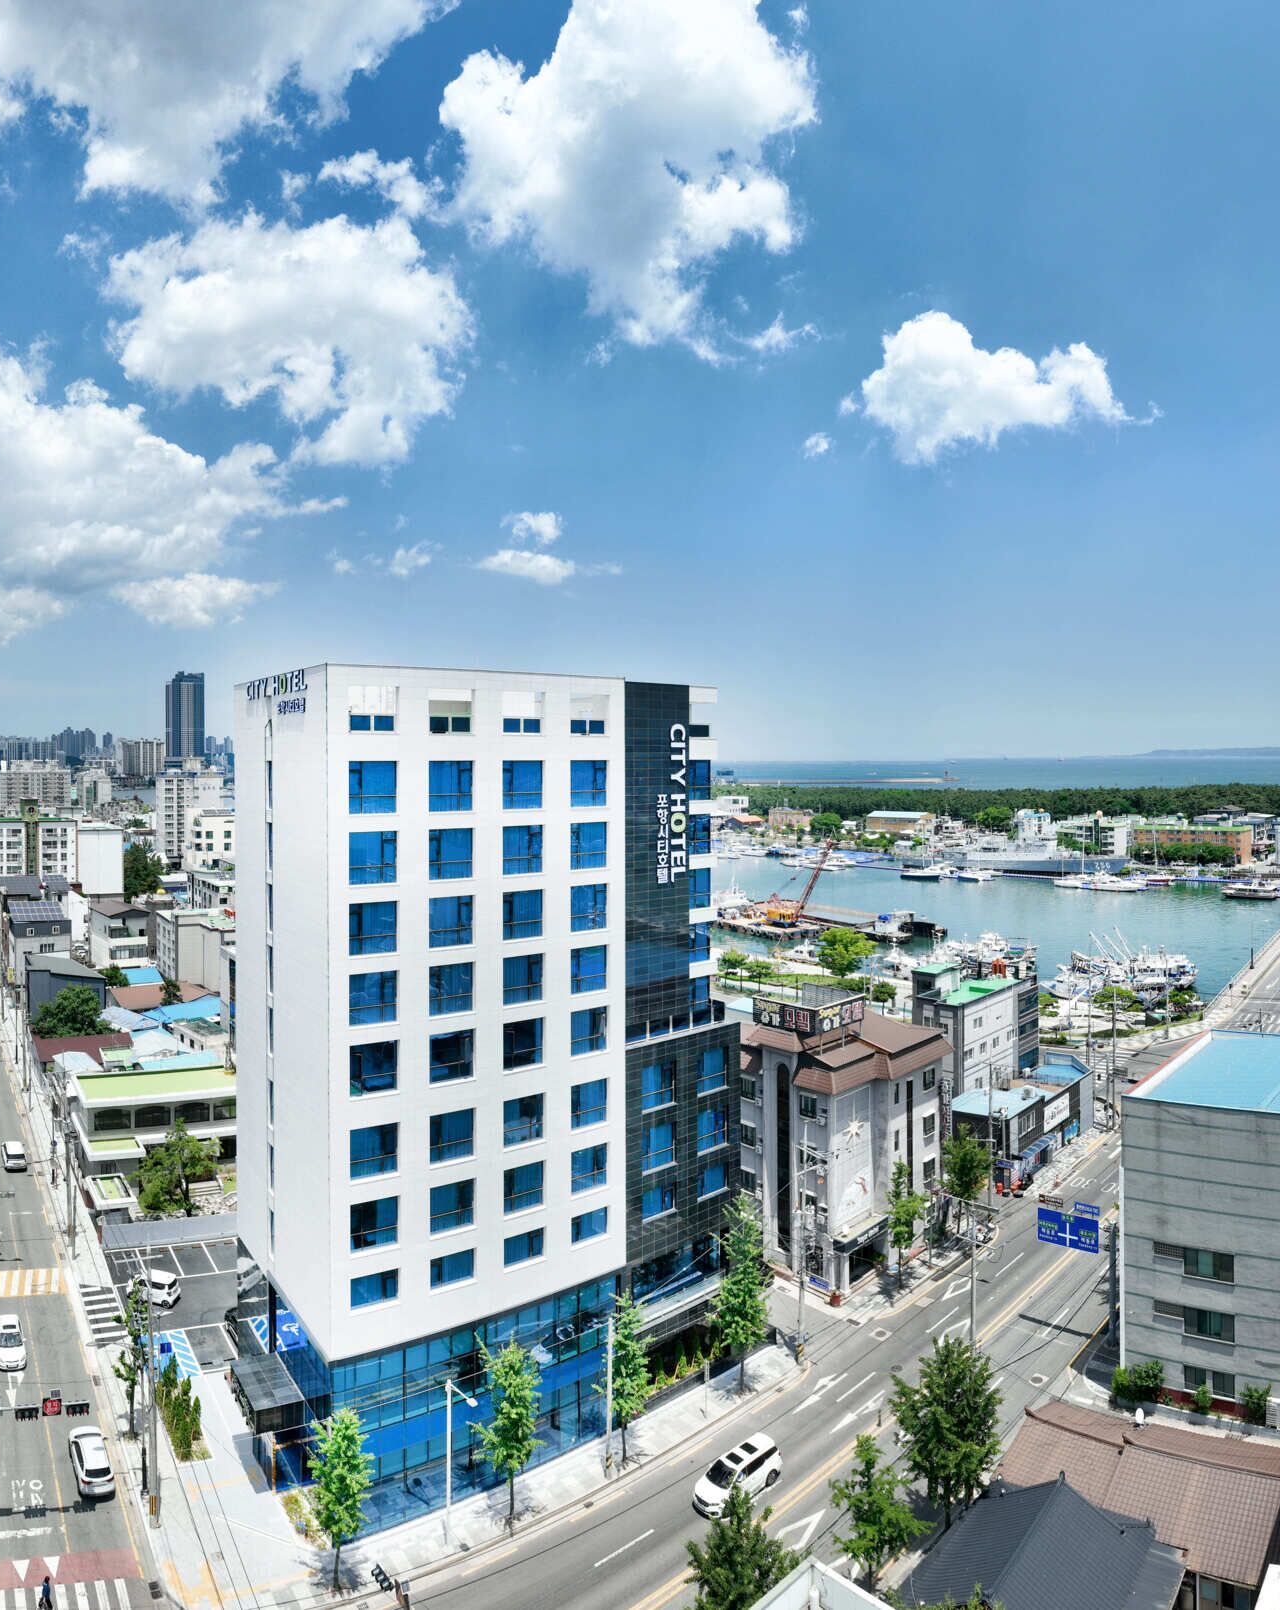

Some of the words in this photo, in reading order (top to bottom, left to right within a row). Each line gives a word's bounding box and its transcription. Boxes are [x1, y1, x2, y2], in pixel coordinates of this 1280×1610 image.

[247, 677, 268, 700] CITY
[273, 669, 307, 696] HOTEL
[670, 723, 687, 787] CITY
[656, 793, 669, 884] 포항시티호텔
[670, 793, 687, 883] HOTEL
